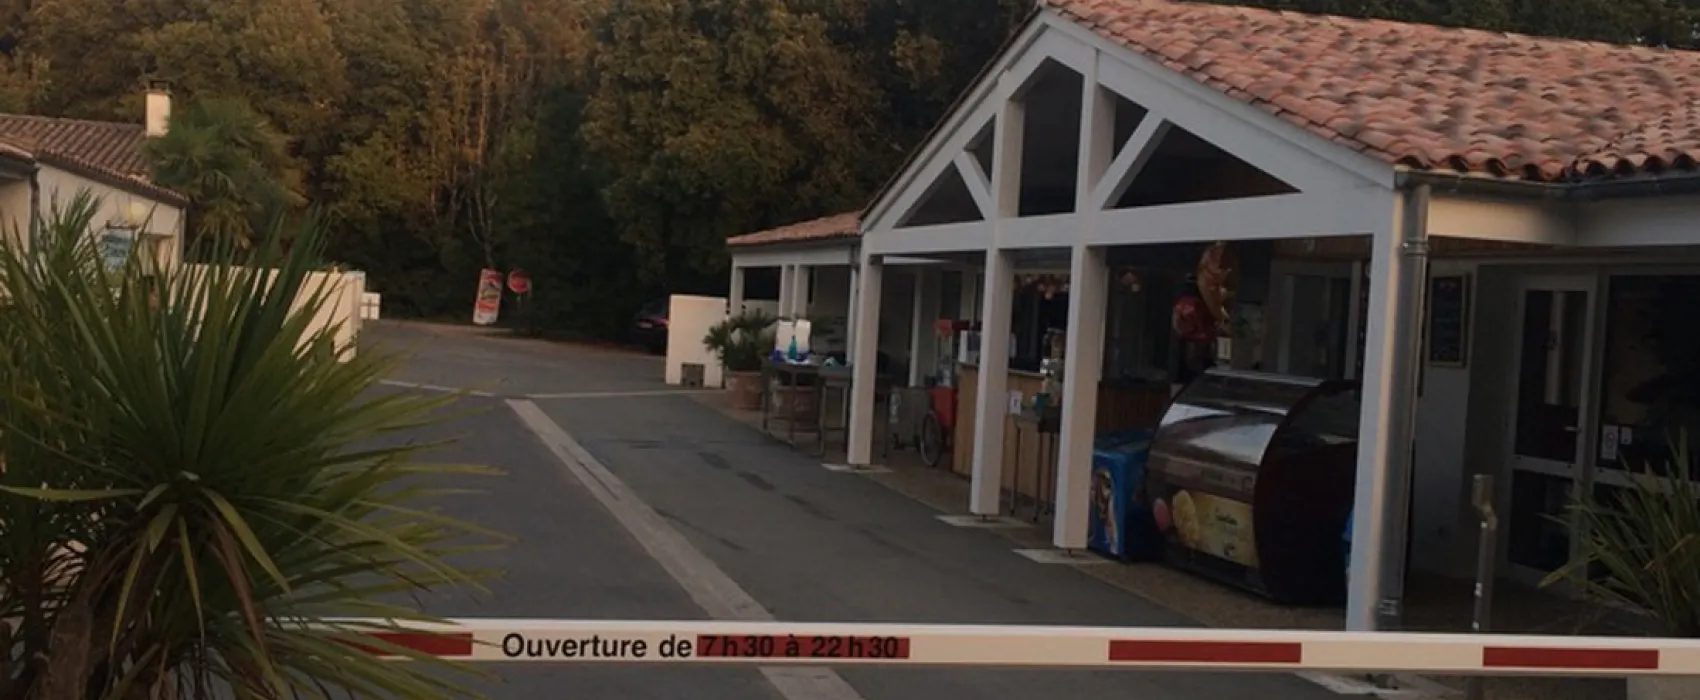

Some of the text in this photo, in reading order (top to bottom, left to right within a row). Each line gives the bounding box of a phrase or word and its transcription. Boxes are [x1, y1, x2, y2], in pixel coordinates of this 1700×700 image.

[502, 632, 647, 657] Ouverture
[659, 633, 692, 657] de
[785, 633, 800, 657] à
